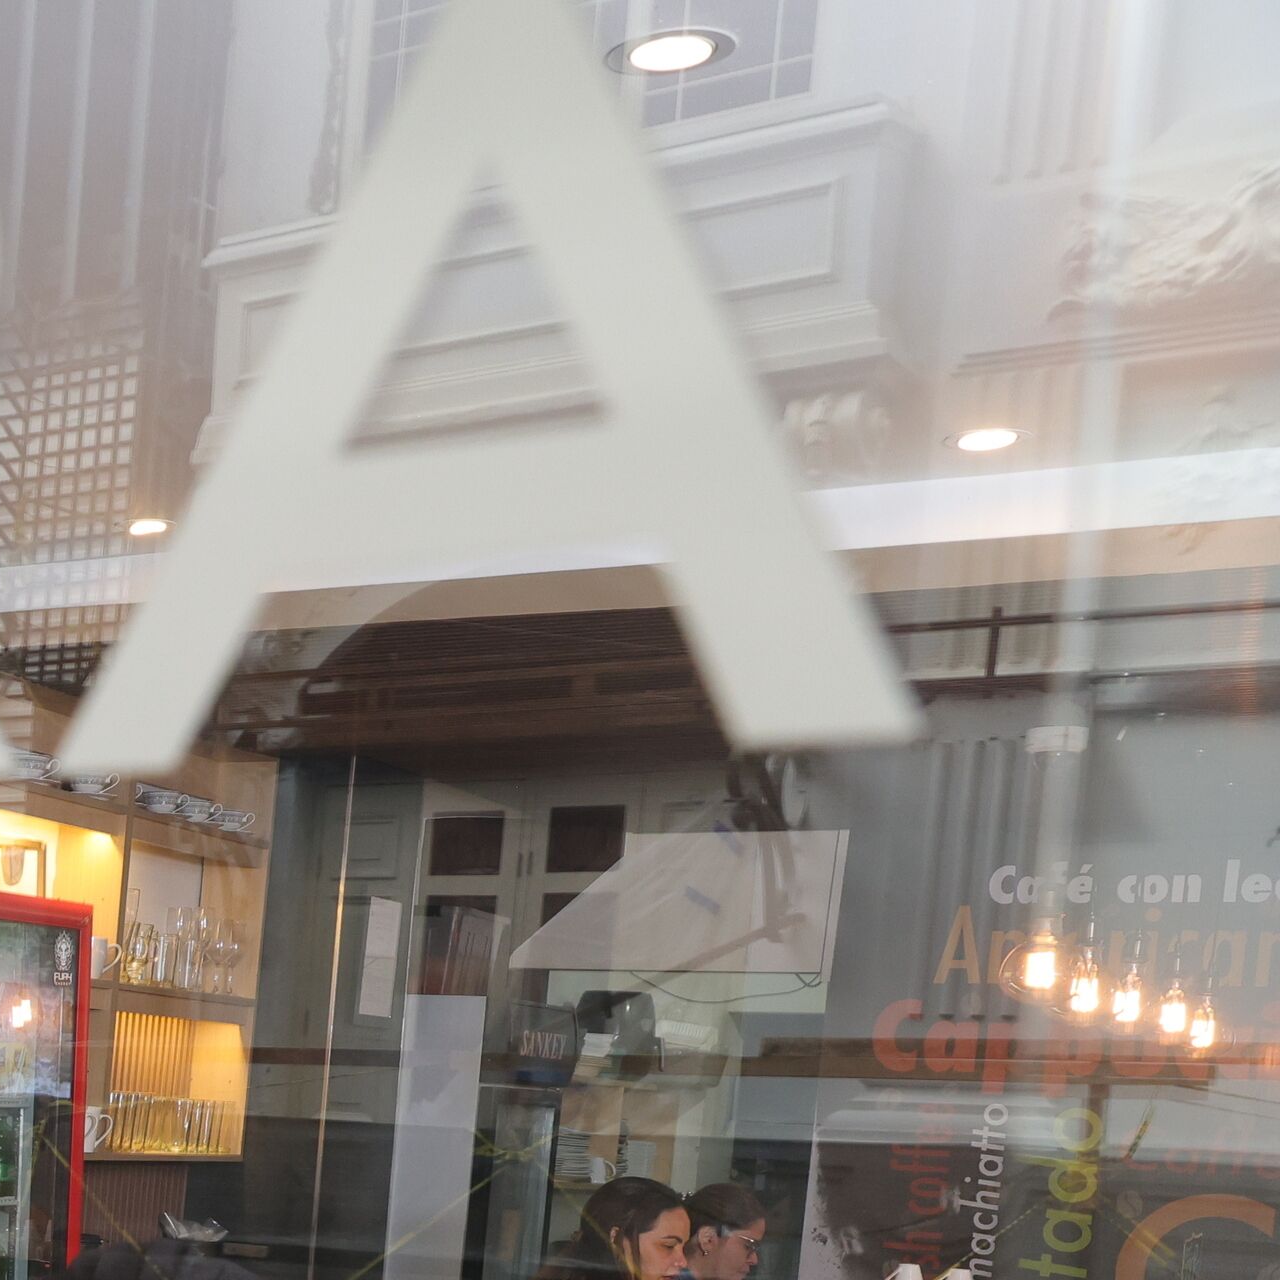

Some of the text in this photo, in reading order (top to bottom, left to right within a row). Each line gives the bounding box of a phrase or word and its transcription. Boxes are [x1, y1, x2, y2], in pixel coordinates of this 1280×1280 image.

[1117, 873, 1202, 904] con
[520, 1030, 568, 1059] SANKEY
[1019, 1107, 1104, 1279] tado
